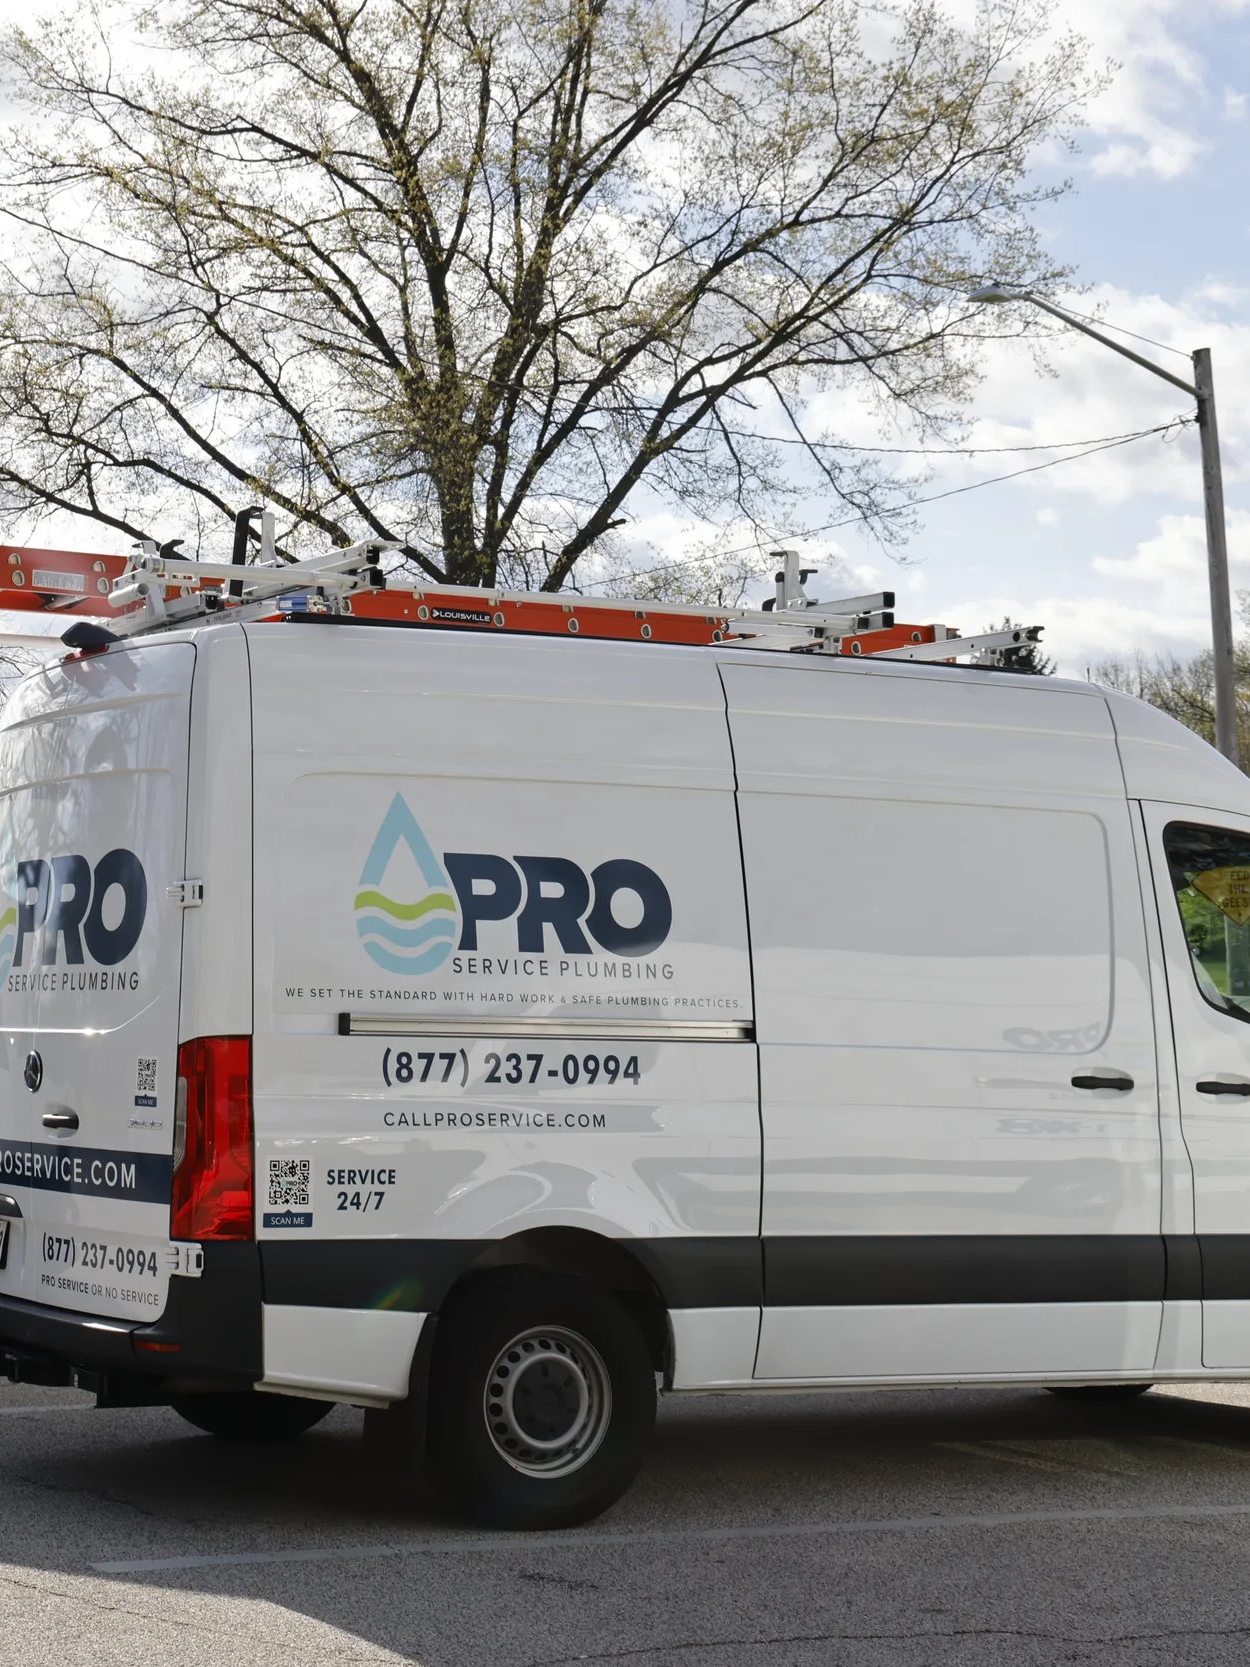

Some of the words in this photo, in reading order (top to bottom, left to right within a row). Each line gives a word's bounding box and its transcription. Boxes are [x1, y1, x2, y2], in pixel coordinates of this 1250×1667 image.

[439, 610, 491, 622] LOUISVILLE
[12, 848, 148, 967] PRO
[443, 852, 672, 958] PRO
[1223, 897, 1250, 908] GEES
[453, 957, 549, 976] SERVICE
[560, 960, 675, 980] PLUMBING
[7, 972, 57, 992] SERVICE
[61, 971, 139, 991] PLUMBING
[285, 988, 304, 998] WE
[310, 988, 333, 998] SET
[339, 989, 364, 999] THE
[369, 990, 438, 1000] STANDARD
[443, 992, 474, 1002] WITH
[480, 993, 514, 1002] HARD
[519, 994, 555, 1003] WORK
[572, 995, 602, 1005] SAFE
[607, 996, 669, 1007] PLUMBING
[381, 1047, 470, 1088] (877)
[484, 1053, 641, 1086] 237-0994
[384, 1112, 607, 1128] CALLPROSERVICE.COM
[326, 1169, 396, 1186] SERVICE
[337, 1191, 386, 1212] 24/7
[270, 1217, 291, 1225] SCAN
[293, 1216, 305, 1225] ME
[42, 1232, 76, 1268] (877)
[81, 1241, 158, 1277] 237-0994
[41, 1273, 56, 1287] PRO
[57, 1278, 89, 1294] SERVICE
[91, 1284, 103, 1296] OR
[105, 1286, 118, 1299] NO
[120, 1289, 159, 1306] SERVICE
